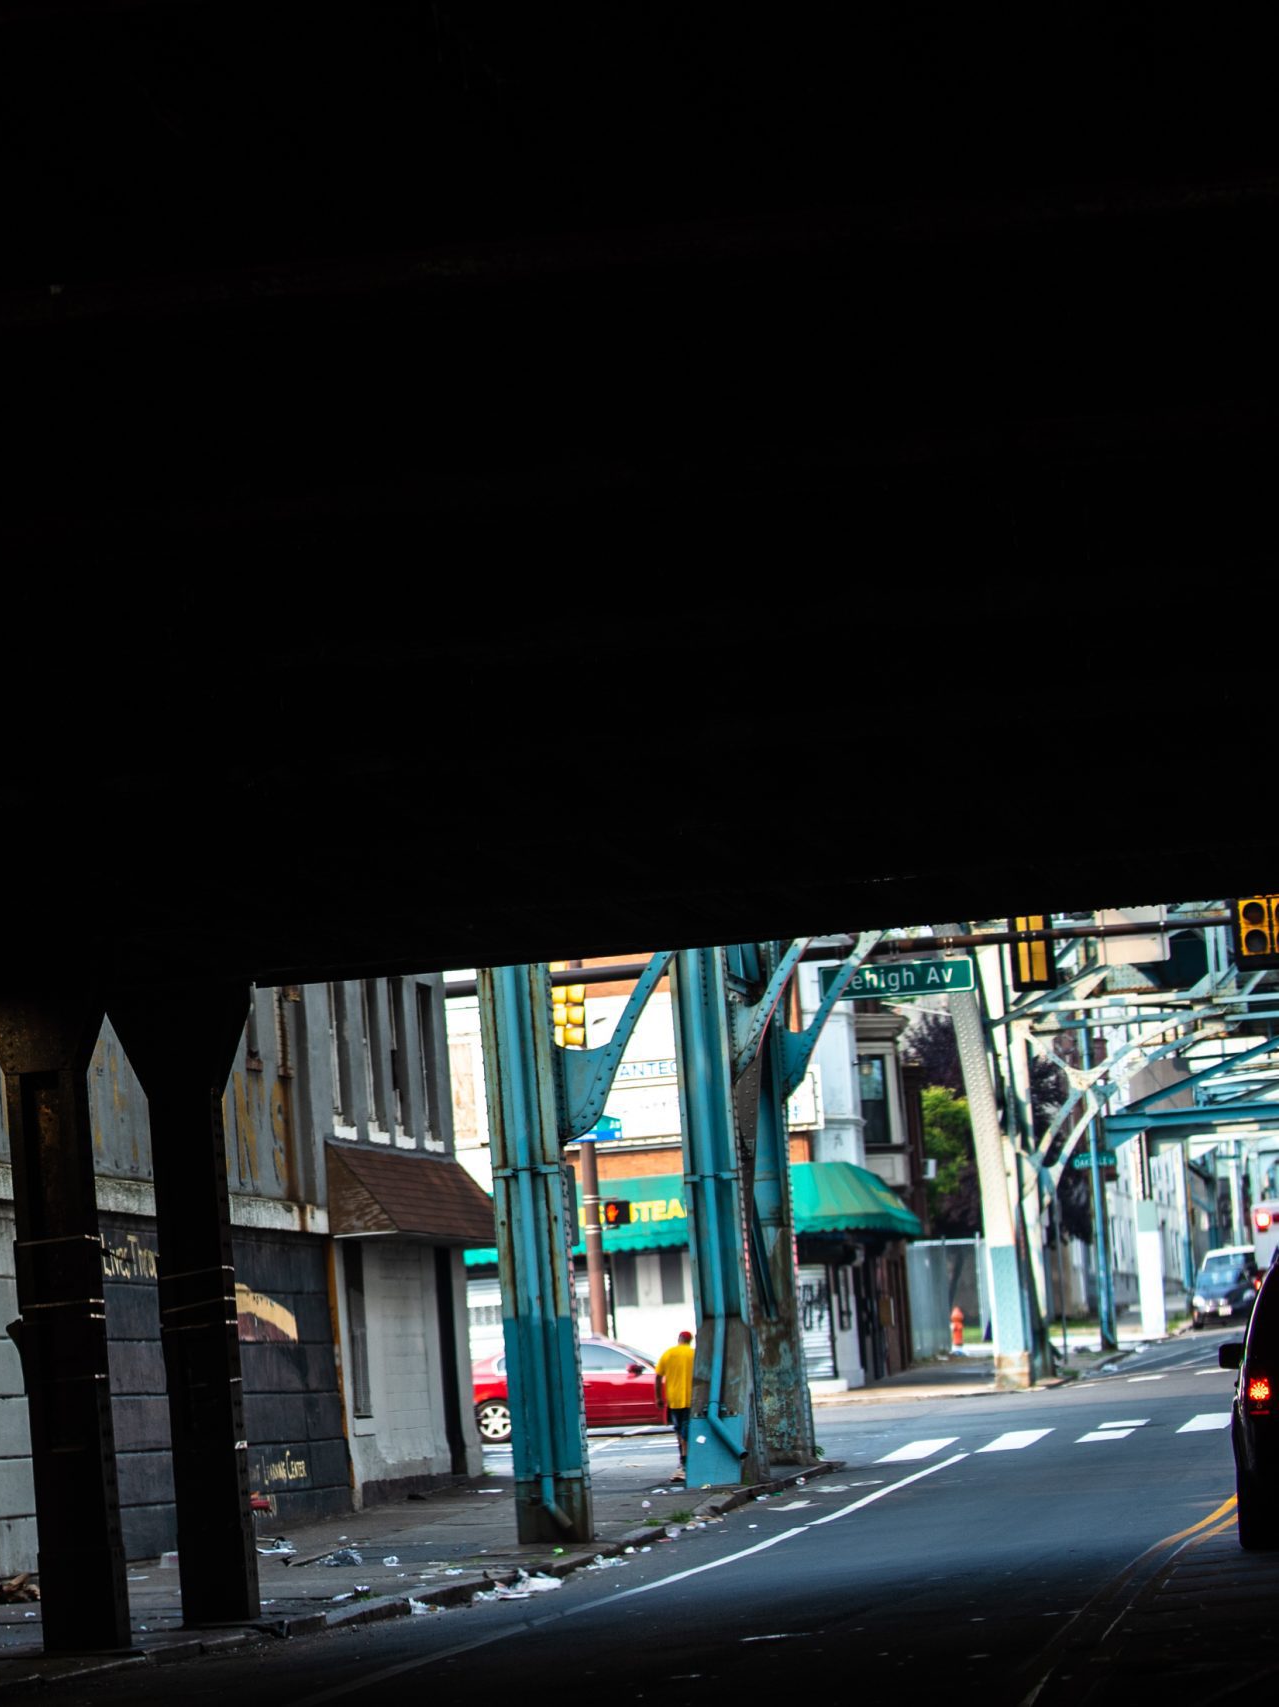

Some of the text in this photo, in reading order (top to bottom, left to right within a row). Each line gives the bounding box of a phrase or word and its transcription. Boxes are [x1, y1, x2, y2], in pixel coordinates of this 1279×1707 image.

[844, 966, 953, 992] ehigh Av
[629, 1199, 687, 1224] STEA
